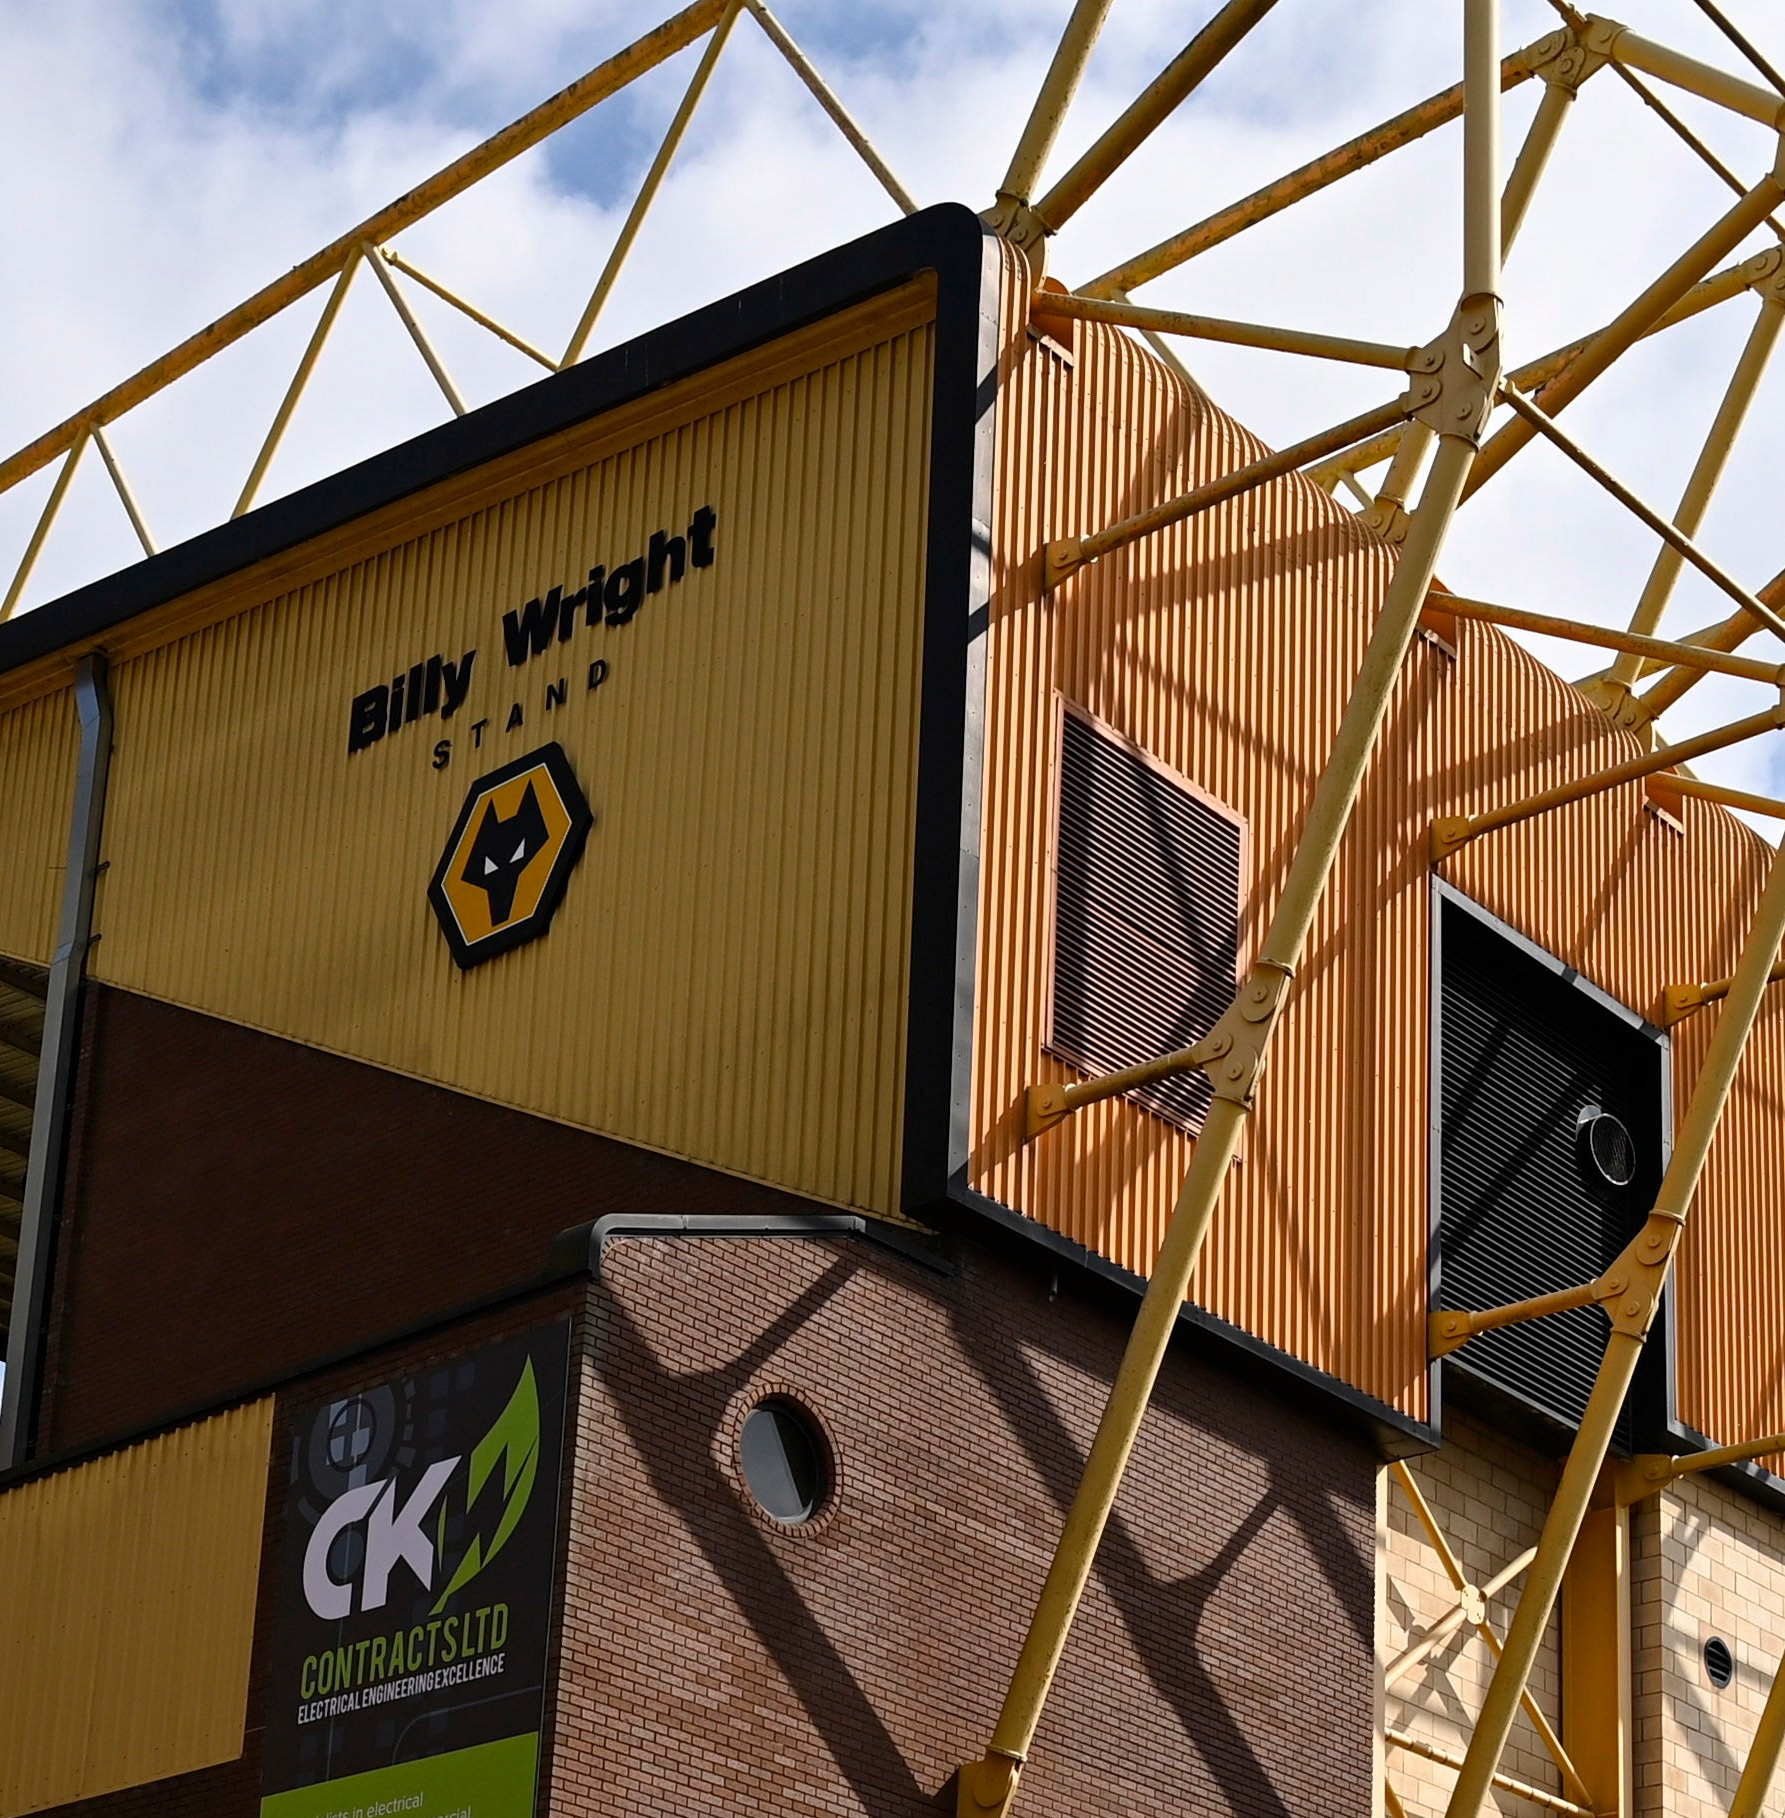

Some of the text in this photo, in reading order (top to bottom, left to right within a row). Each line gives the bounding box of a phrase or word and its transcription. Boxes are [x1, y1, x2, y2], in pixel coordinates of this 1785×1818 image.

[348, 505, 717, 757] Billy Wright
[432, 658, 609, 769] STAND
[297, 1653, 506, 1725] ELECTRICAL ENGINEERING EXCELLENCE
[300, 1602, 510, 1700] CONTRACTS LTD
